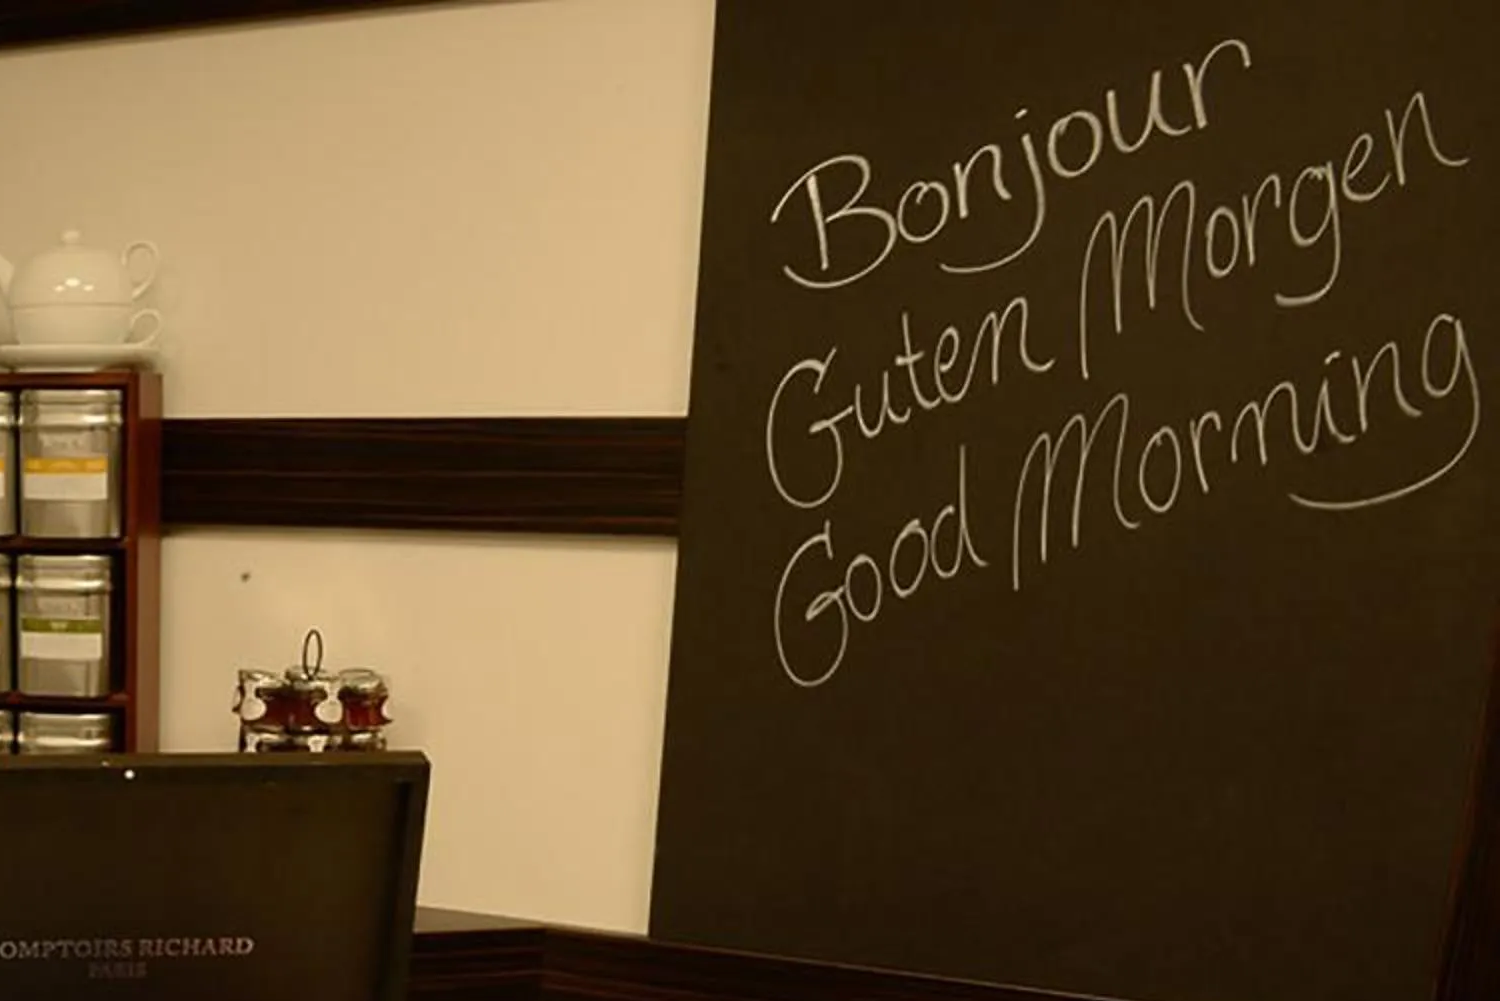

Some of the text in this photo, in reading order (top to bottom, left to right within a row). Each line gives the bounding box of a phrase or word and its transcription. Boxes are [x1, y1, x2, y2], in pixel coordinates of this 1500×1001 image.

[766, 91, 1470, 508] Guten Morgen
[771, 38, 1252, 290] Bonjour
[775, 312, 1481, 687] Good Morning
[138, 936, 256, 957] RICHARD
